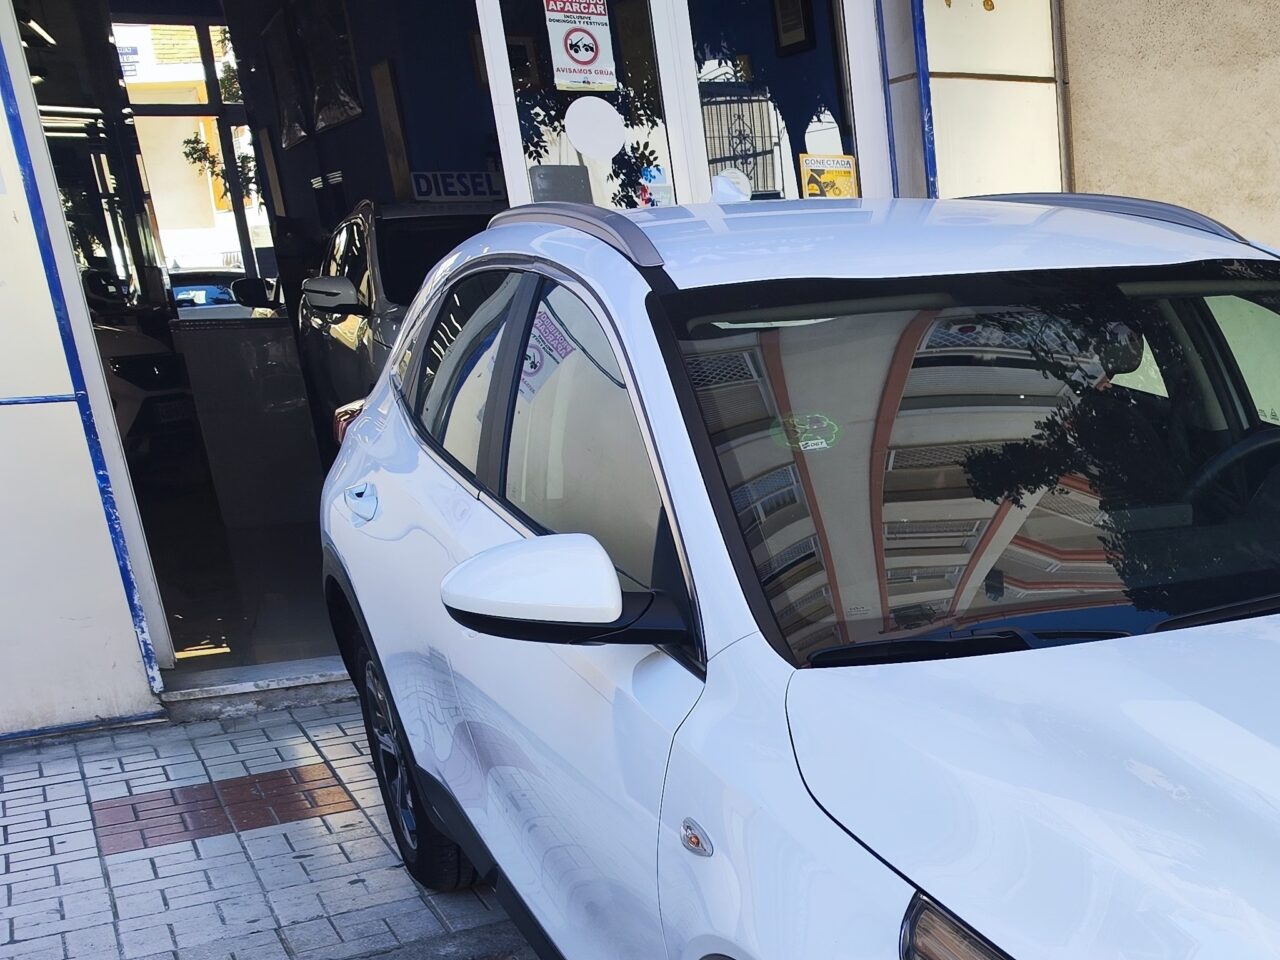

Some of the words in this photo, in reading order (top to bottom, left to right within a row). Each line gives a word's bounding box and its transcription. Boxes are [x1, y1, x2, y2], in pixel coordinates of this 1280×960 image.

[548, 1, 605, 14] APARCAR
[555, 67, 593, 75] AVISAMOS
[804, 158, 851, 167] CONECTADA
[413, 173, 503, 197] DIESEL
